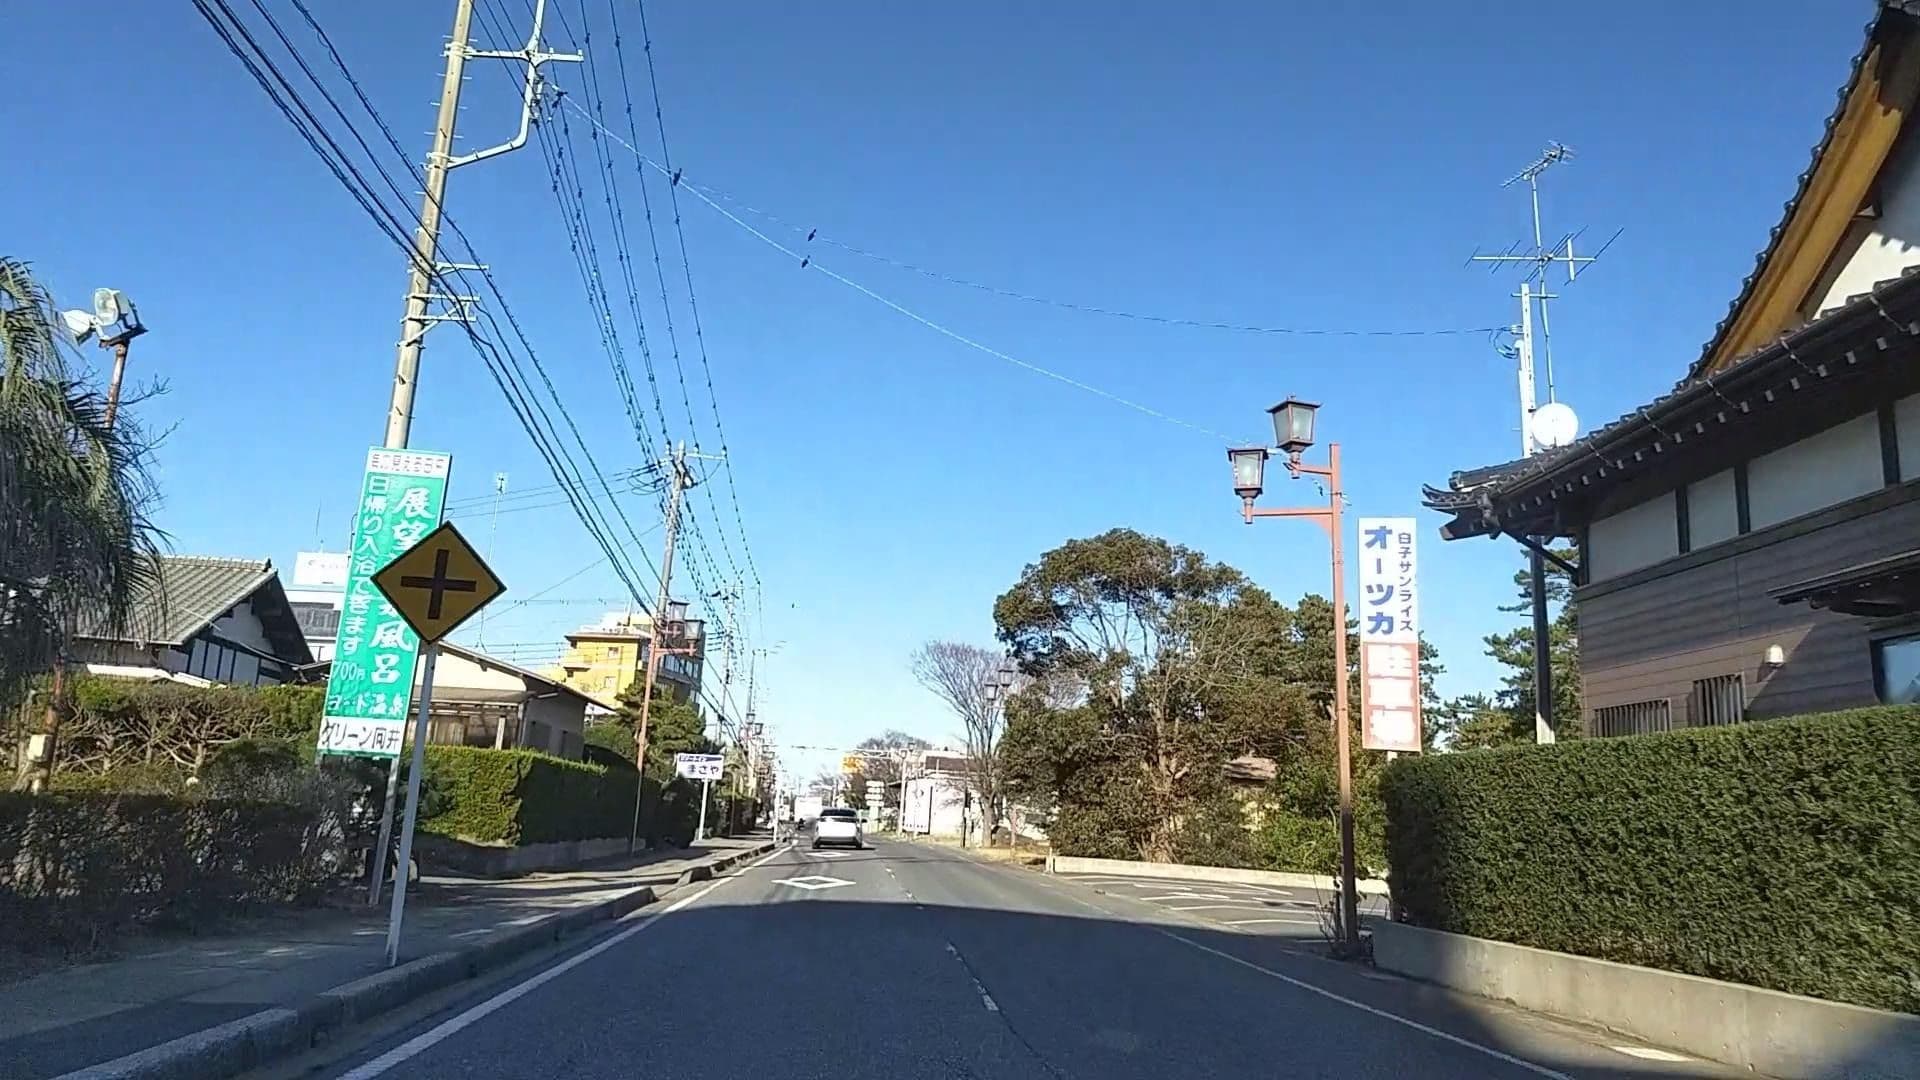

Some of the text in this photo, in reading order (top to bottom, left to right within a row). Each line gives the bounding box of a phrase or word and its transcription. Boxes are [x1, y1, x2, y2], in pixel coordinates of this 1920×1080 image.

[368, 486, 436, 684] 展望風呂
[1364, 526, 1395, 636] オーツカ
[321, 718, 401, 751] グリーン向井
